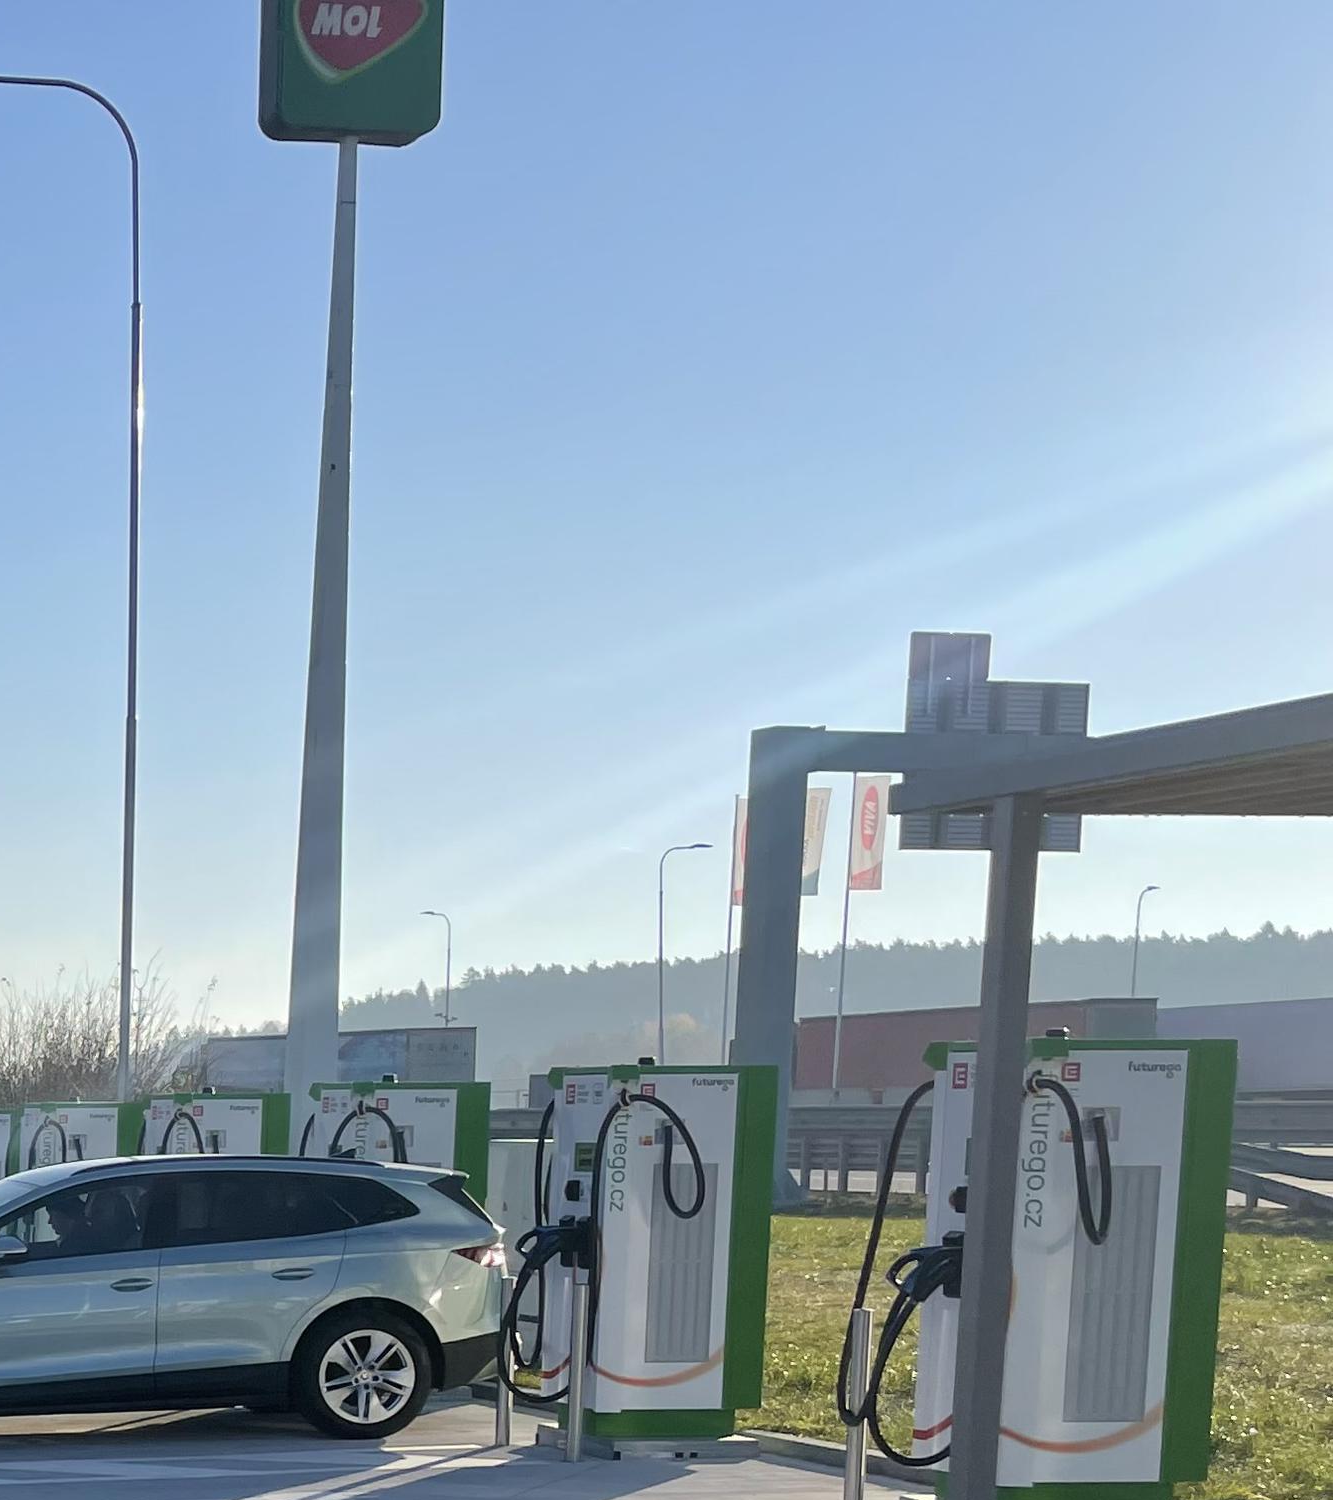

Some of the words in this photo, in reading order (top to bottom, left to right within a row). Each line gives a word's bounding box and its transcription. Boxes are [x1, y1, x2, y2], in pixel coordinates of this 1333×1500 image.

[311, 3, 383, 38] MOL
[1128, 1061, 1182, 1079] futurego
[607, 1107, 633, 1212] turego.cz
